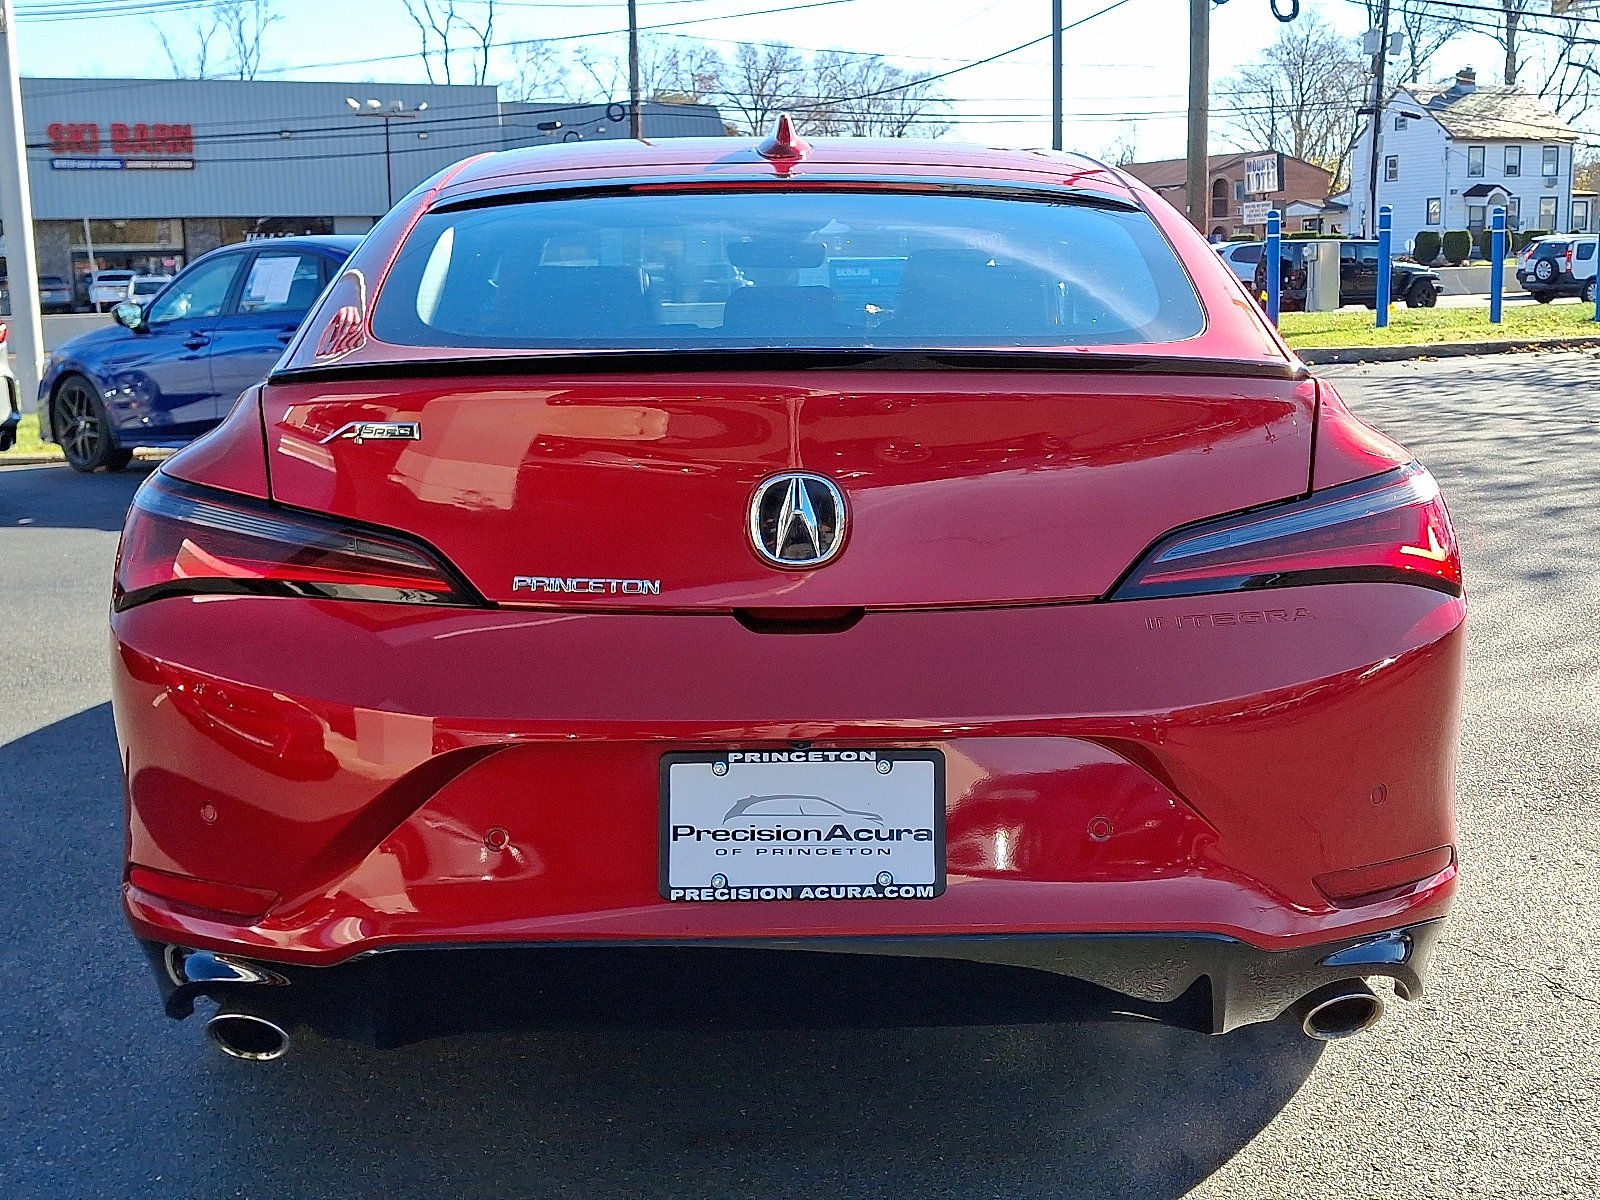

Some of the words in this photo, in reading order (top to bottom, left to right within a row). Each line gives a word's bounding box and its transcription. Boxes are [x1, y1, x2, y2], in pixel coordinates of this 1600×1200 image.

[48, 123, 99, 153] SKI
[110, 123, 194, 153] BARN
[1246, 158, 1276, 172] MOUNTS
[512, 575, 661, 594] PRINCETON
[1144, 607, 1317, 630] INTEGRA
[728, 751, 877, 763] PRINCETON
[715, 848, 743, 856] OF
[756, 847, 892, 856] PRINCETON
[670, 887, 792, 900] PRECISION
[800, 886, 934, 899] ACURA.COM
